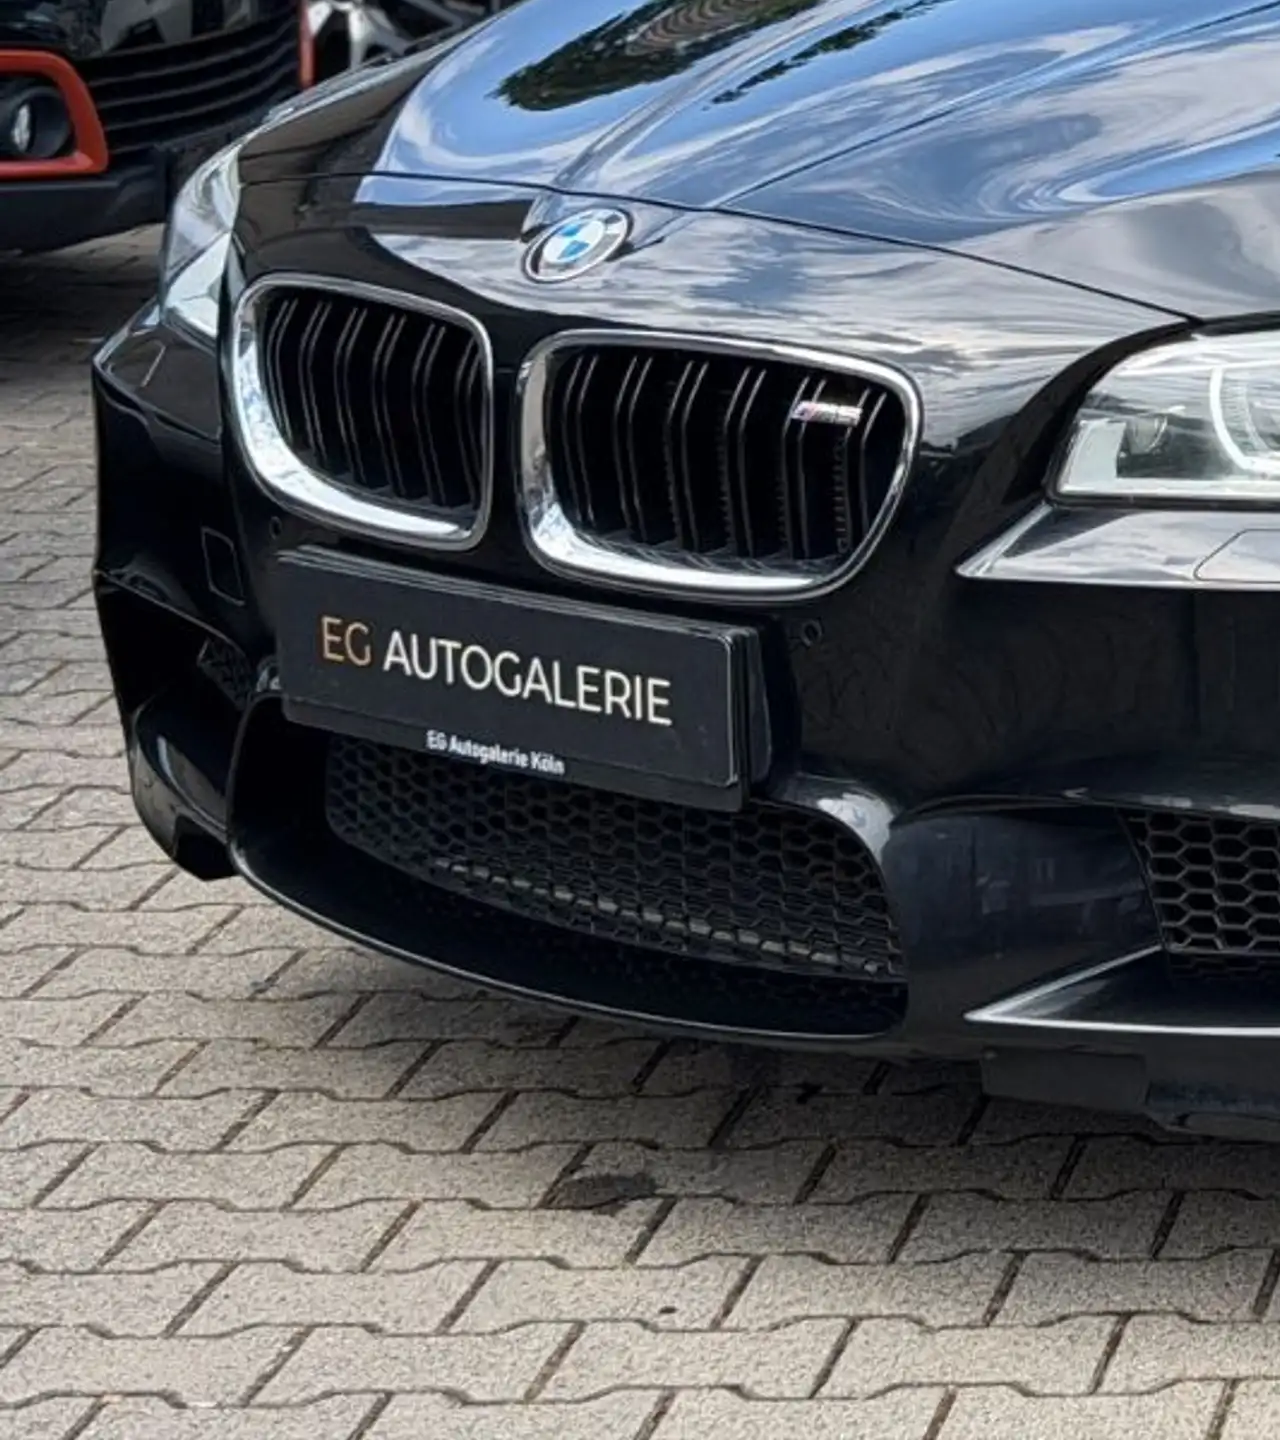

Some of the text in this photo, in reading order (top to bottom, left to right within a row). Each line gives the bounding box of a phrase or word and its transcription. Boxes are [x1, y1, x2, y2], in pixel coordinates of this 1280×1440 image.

[321, 616, 673, 726] EG AUTOGALERIE
[426, 729, 566, 776] EG Autogalerie Köln
